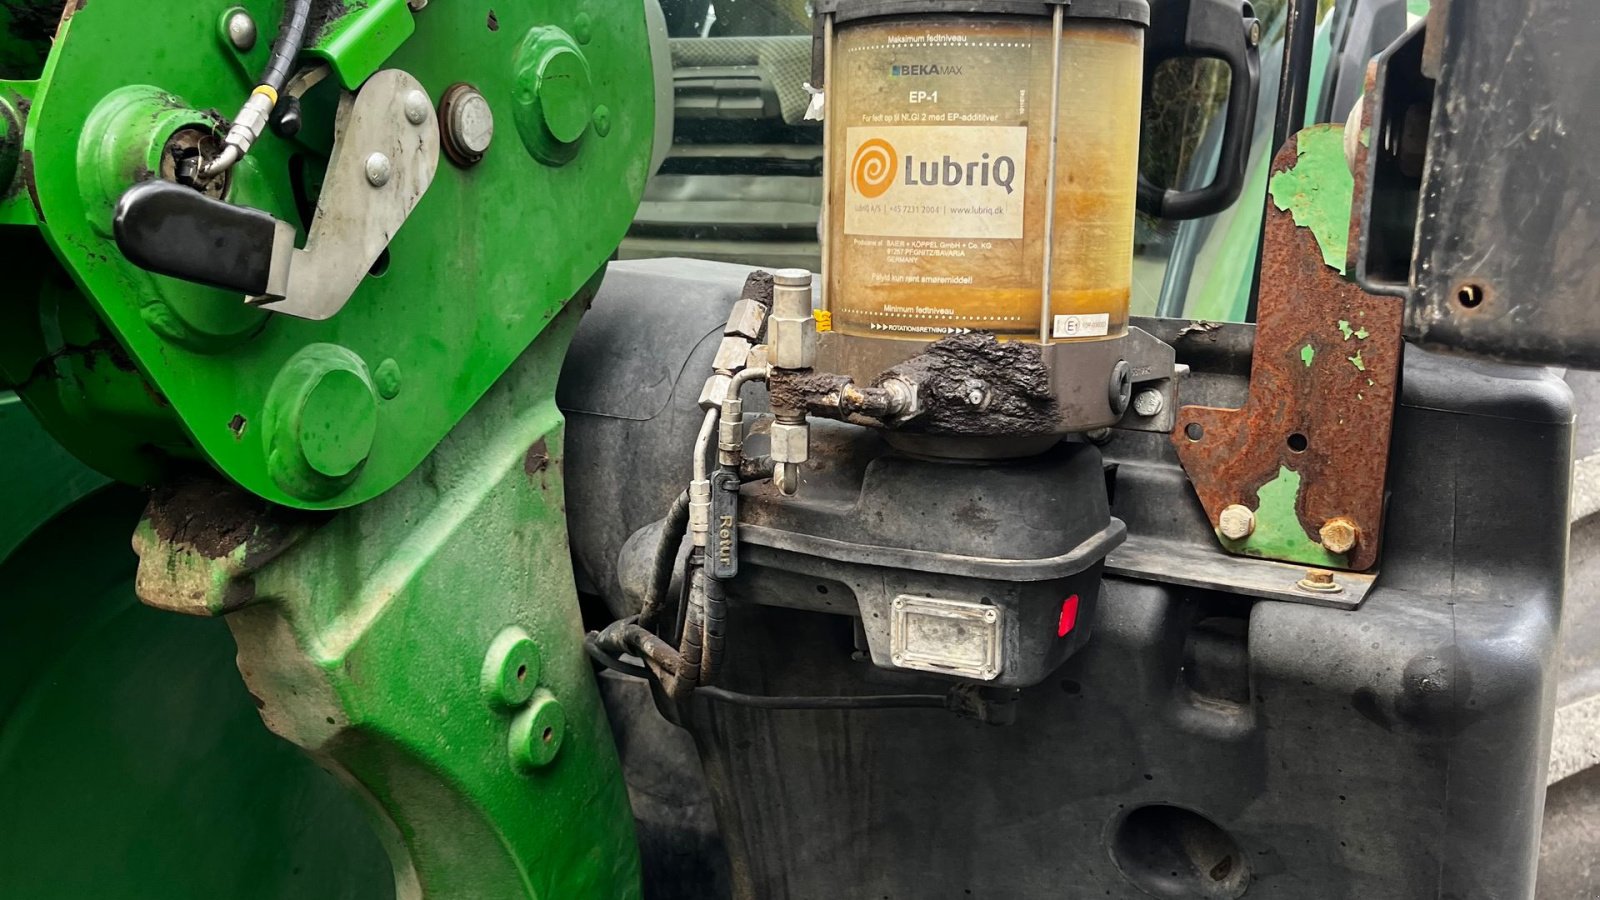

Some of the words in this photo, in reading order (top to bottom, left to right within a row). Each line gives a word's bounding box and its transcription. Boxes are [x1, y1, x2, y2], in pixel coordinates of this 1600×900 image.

[888, 35, 925, 43] Maksimum
[926, 34, 967, 42] fedtniveau
[909, 90, 938, 103] EP-1
[884, 114, 894, 123] op
[901, 112, 920, 121] NLGI
[921, 112, 927, 121] 2
[928, 112, 946, 121] med
[904, 152, 1015, 195] LubriQ
[921, 205, 940, 214] 2004
[950, 205, 1004, 216] www.lubriq.dk
[940, 241, 961, 249] GmbH
[981, 242, 993, 250] KG
[886, 256, 918, 264] GERMANY
[891, 274, 904, 283] kun
[883, 304, 914, 313] Minimum
[915, 306, 955, 315] fedtniveau
[888, 324, 947, 334] ROTATIONSRETNING
[720, 515, 733, 567] Retur
